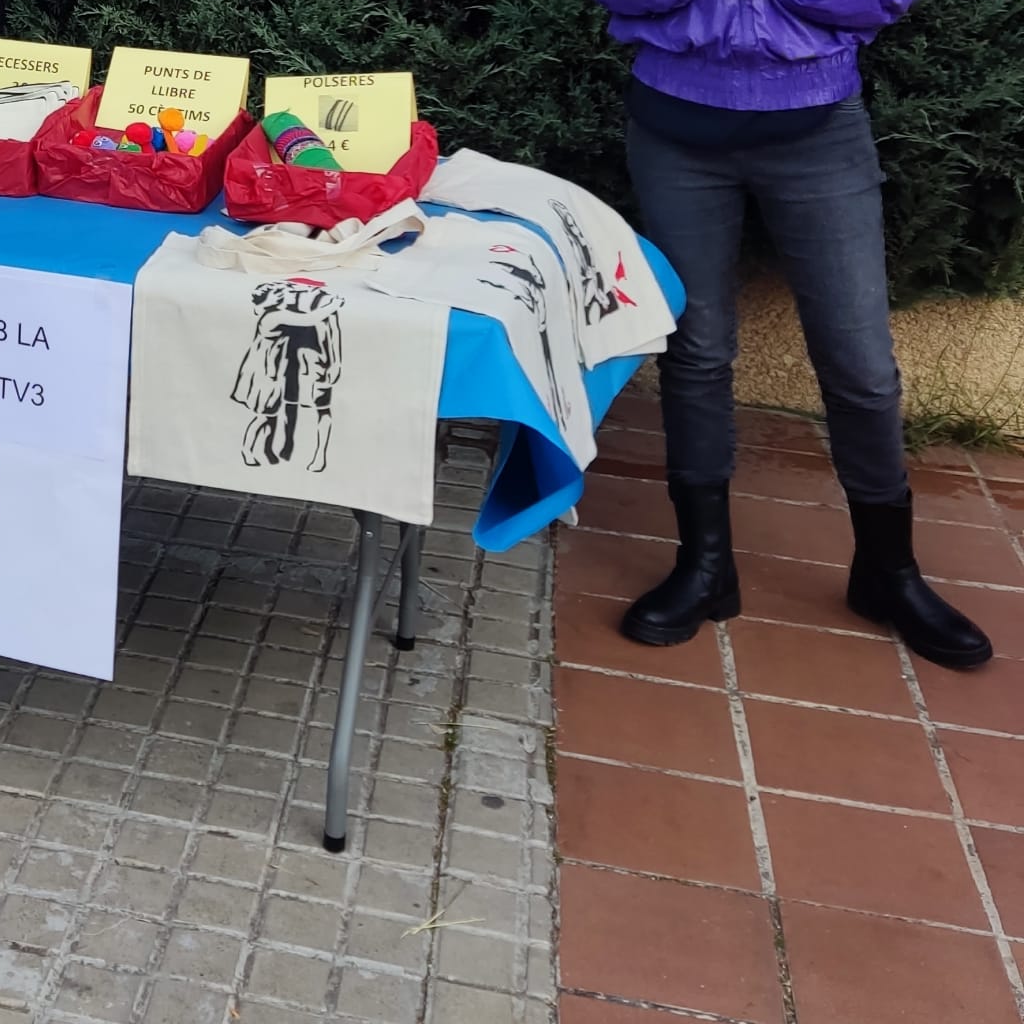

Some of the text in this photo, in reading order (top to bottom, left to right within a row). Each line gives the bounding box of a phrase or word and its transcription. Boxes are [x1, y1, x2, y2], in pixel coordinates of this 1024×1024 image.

[144, 65, 212, 82] PUNTS DE
[303, 75, 375, 88] POLSERES
[151, 85, 197, 100] LLIBRE
[127, 103, 211, 122] 50 CÈIMS
[341, 139, 350, 151] €
[17, 322, 51, 351] LA
